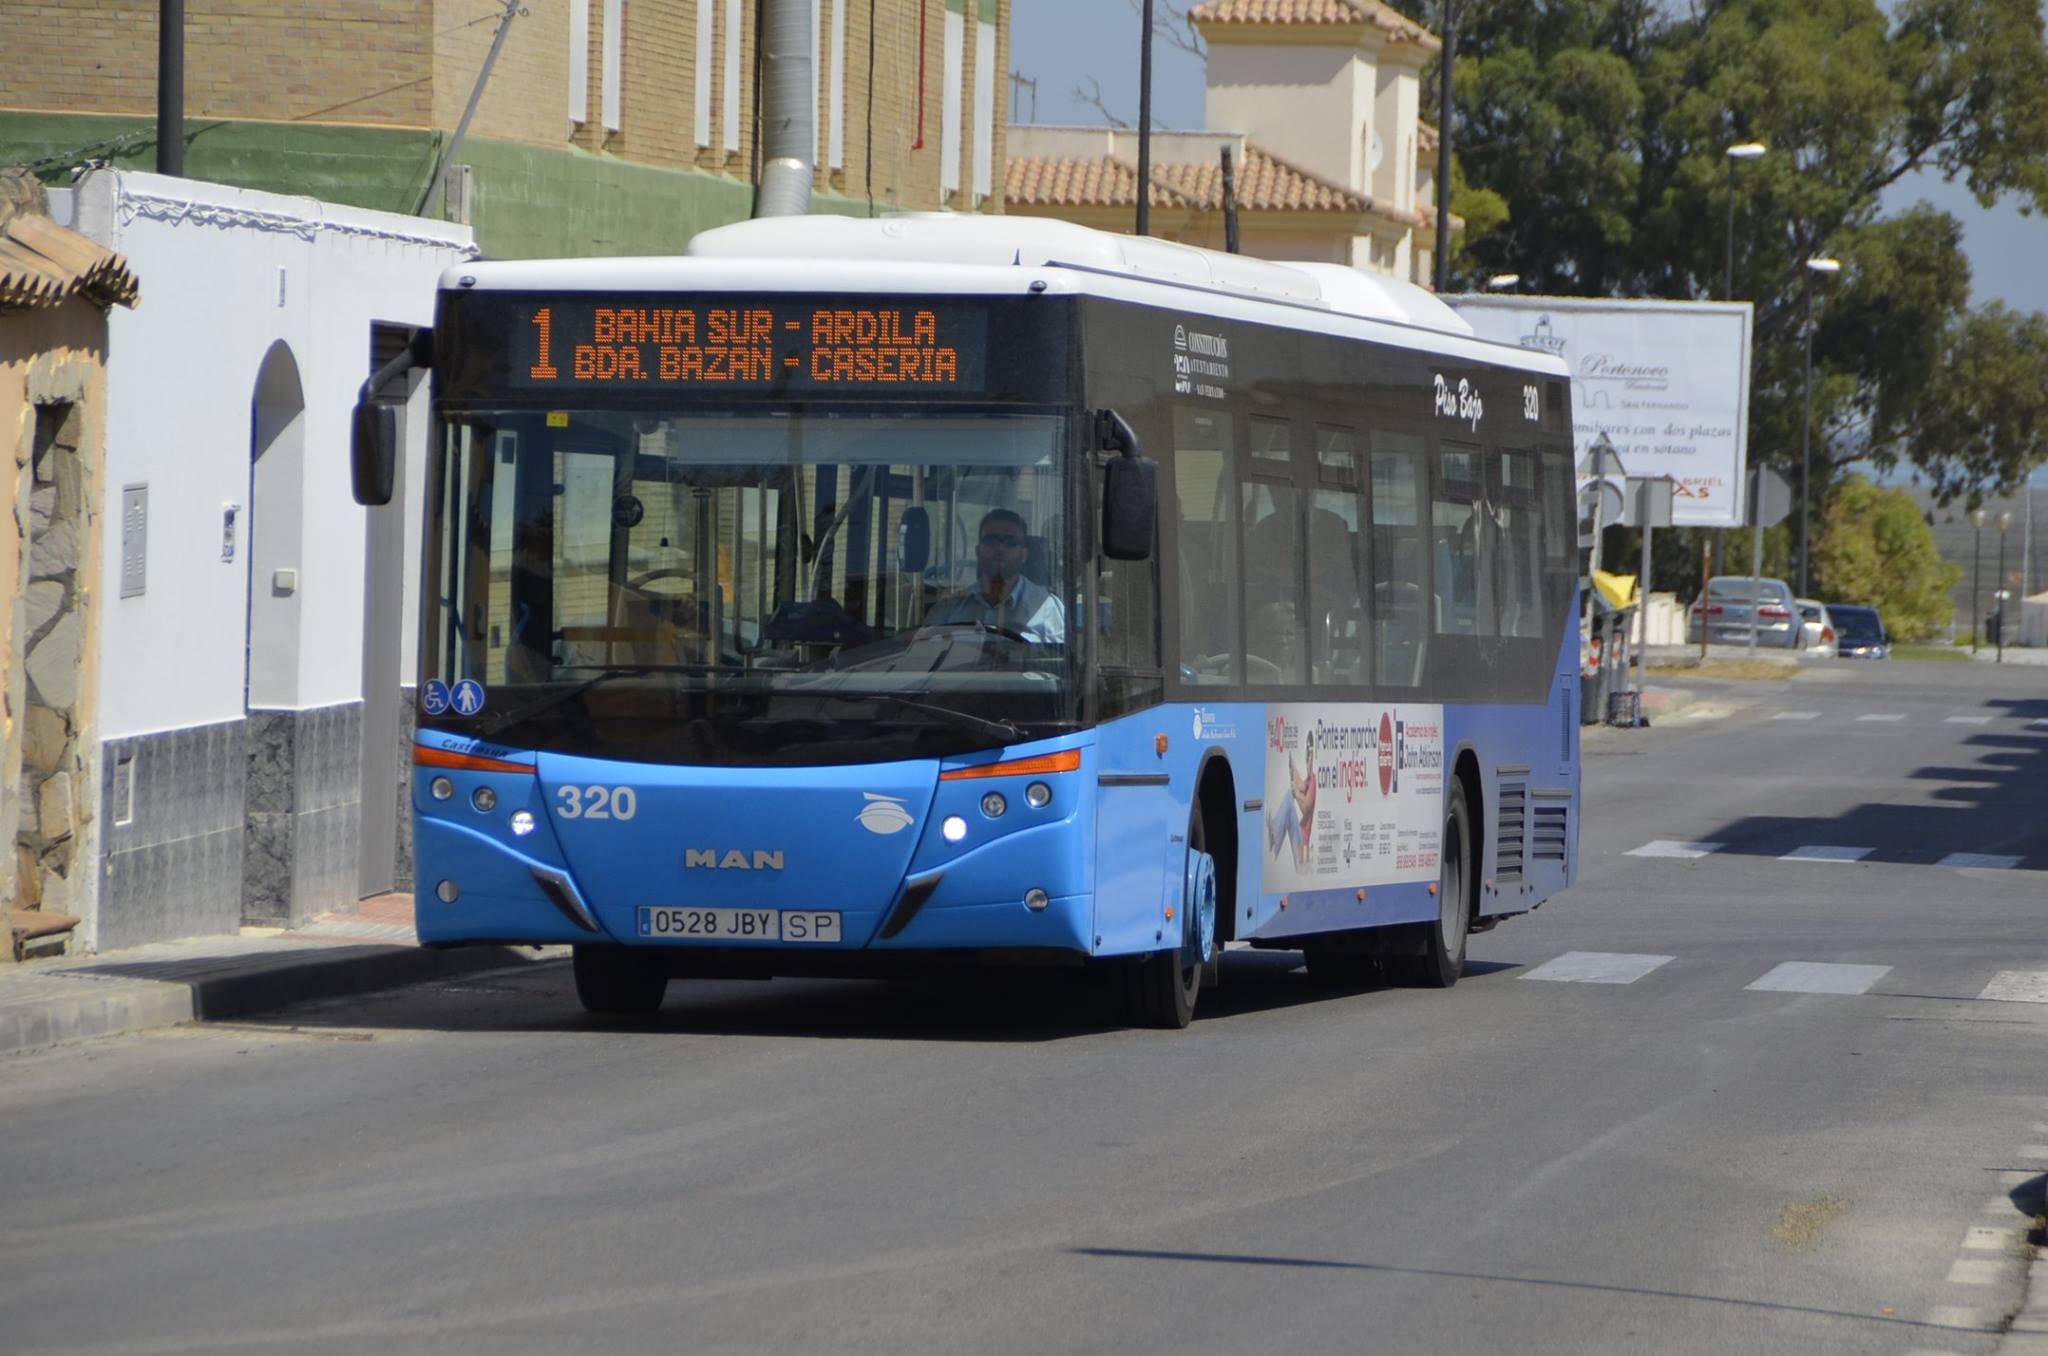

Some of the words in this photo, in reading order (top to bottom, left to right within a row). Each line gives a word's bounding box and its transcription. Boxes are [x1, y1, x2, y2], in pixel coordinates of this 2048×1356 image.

[531, 308, 557, 379] 1
[595, 308, 696, 343] BAHIA
[707, 310, 773, 344] SUR
[812, 311, 935, 345] ARDILA
[575, 345, 648, 379] BDA.
[661, 346, 772, 381] BAZAN
[811, 348, 956, 382] CASERIA
[1434, 373, 1457, 417] Piso
[1459, 378, 1483, 433] Bajo
[1523, 385, 1539, 421] 320
[1634, 425, 1656, 436] con
[1664, 422, 1686, 437] dos
[1689, 424, 1732, 440] plazas
[1340, 727, 1350, 750] en
[1350, 718, 1377, 750] marcha
[1318, 766, 1331, 788] con
[557, 785, 636, 820] 320
[685, 849, 784, 870] MAN
[656, 910, 718, 934] 0528
[727, 912, 770, 935] JBY
[789, 915, 833, 938] SP
